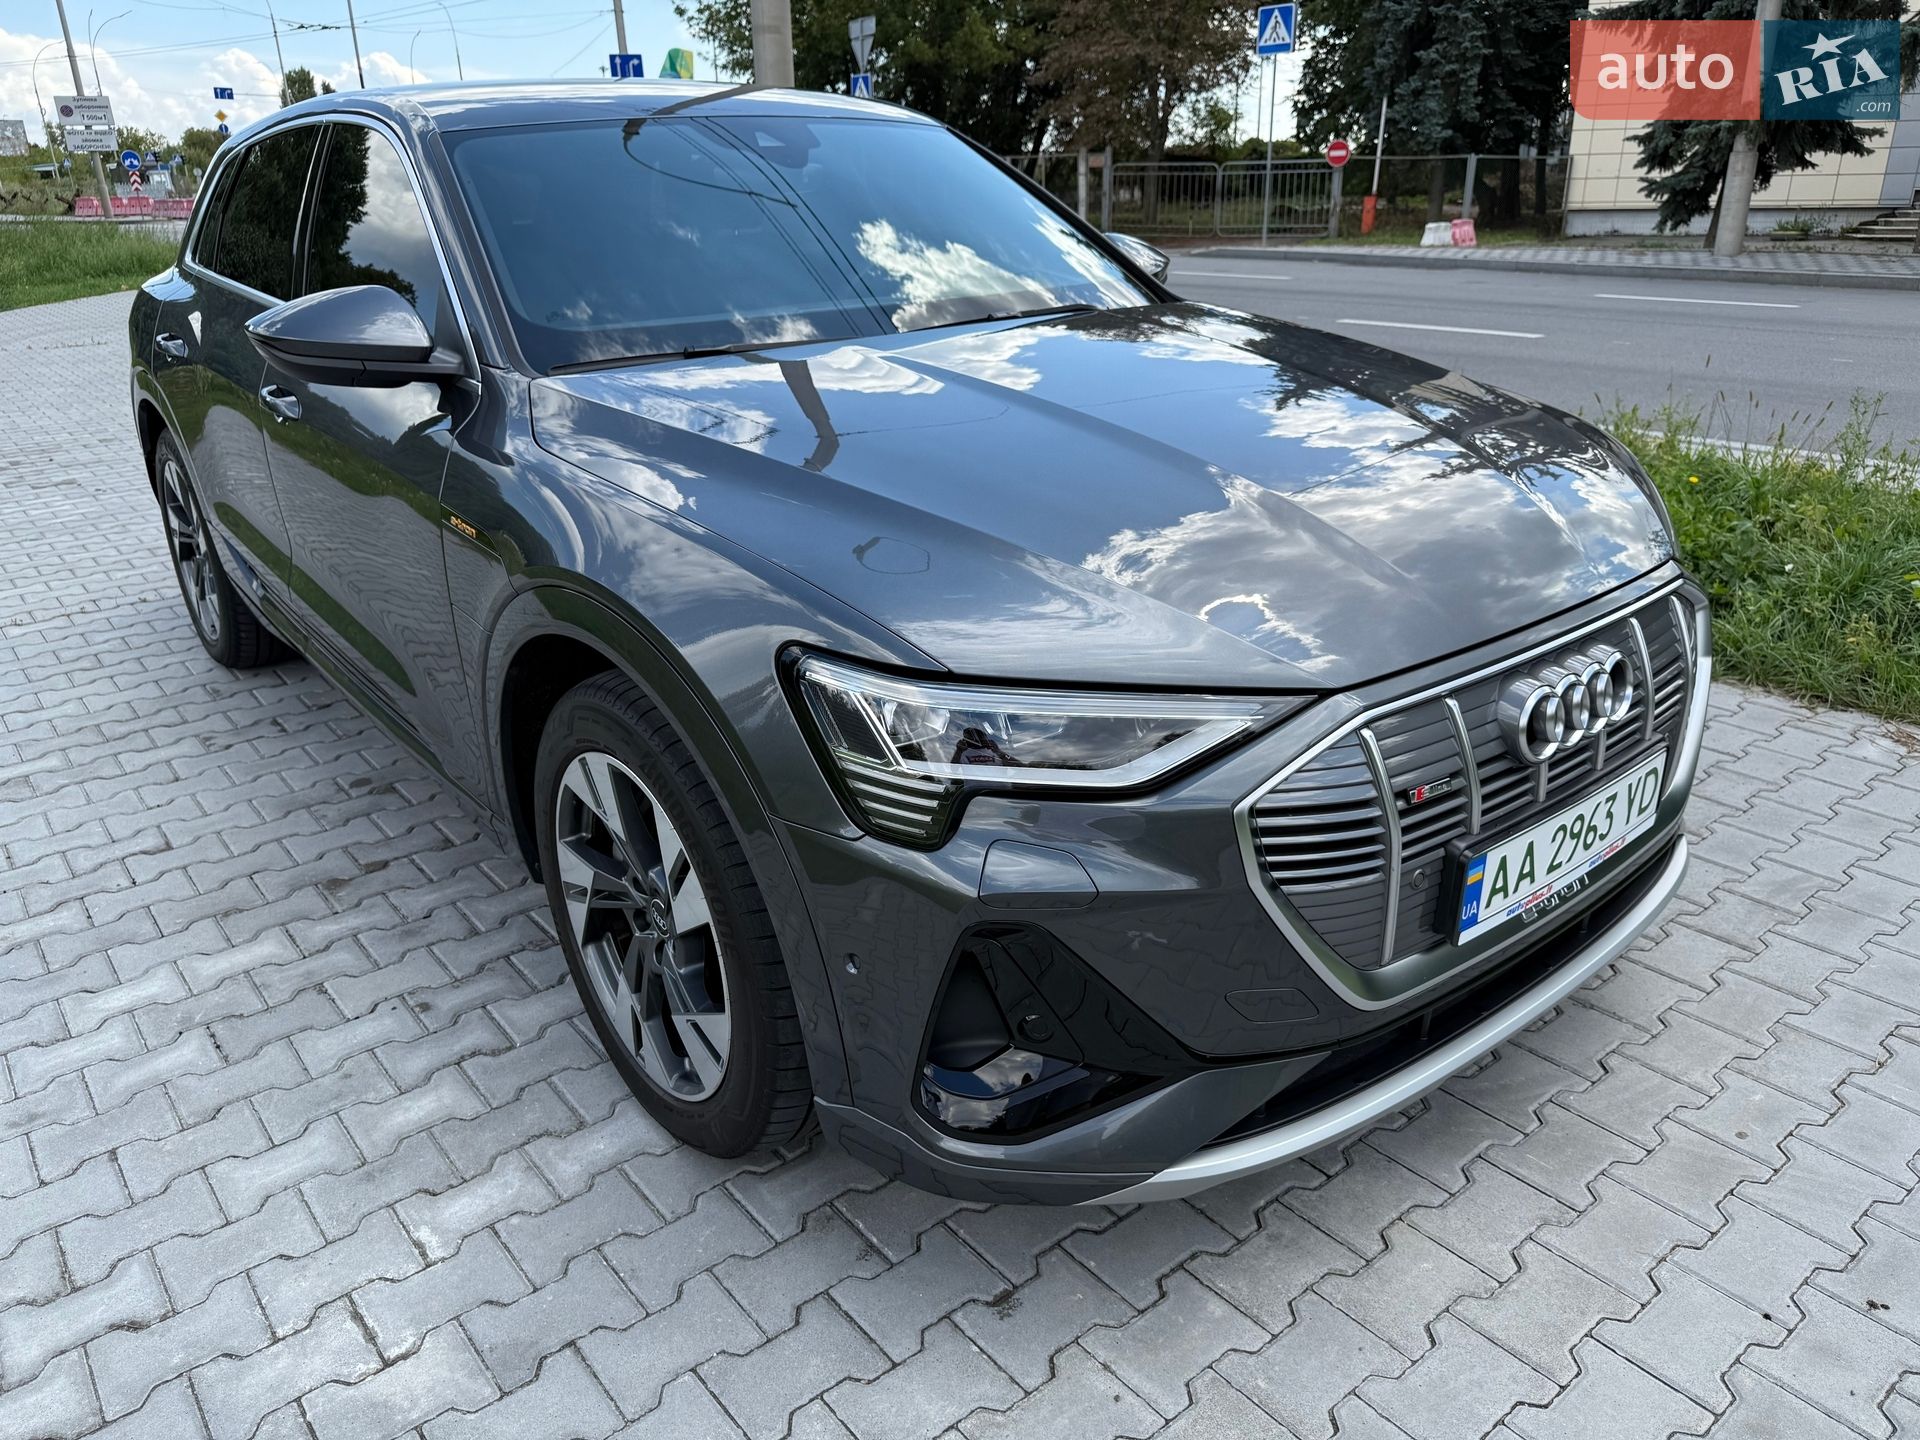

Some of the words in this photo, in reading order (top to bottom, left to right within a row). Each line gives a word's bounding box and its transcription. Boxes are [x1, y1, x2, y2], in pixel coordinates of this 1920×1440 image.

[1485, 840, 1536, 910] AA
[1546, 791, 1619, 876] 2963
[1624, 766, 1660, 826] YD
[1462, 902, 1478, 920] UA
